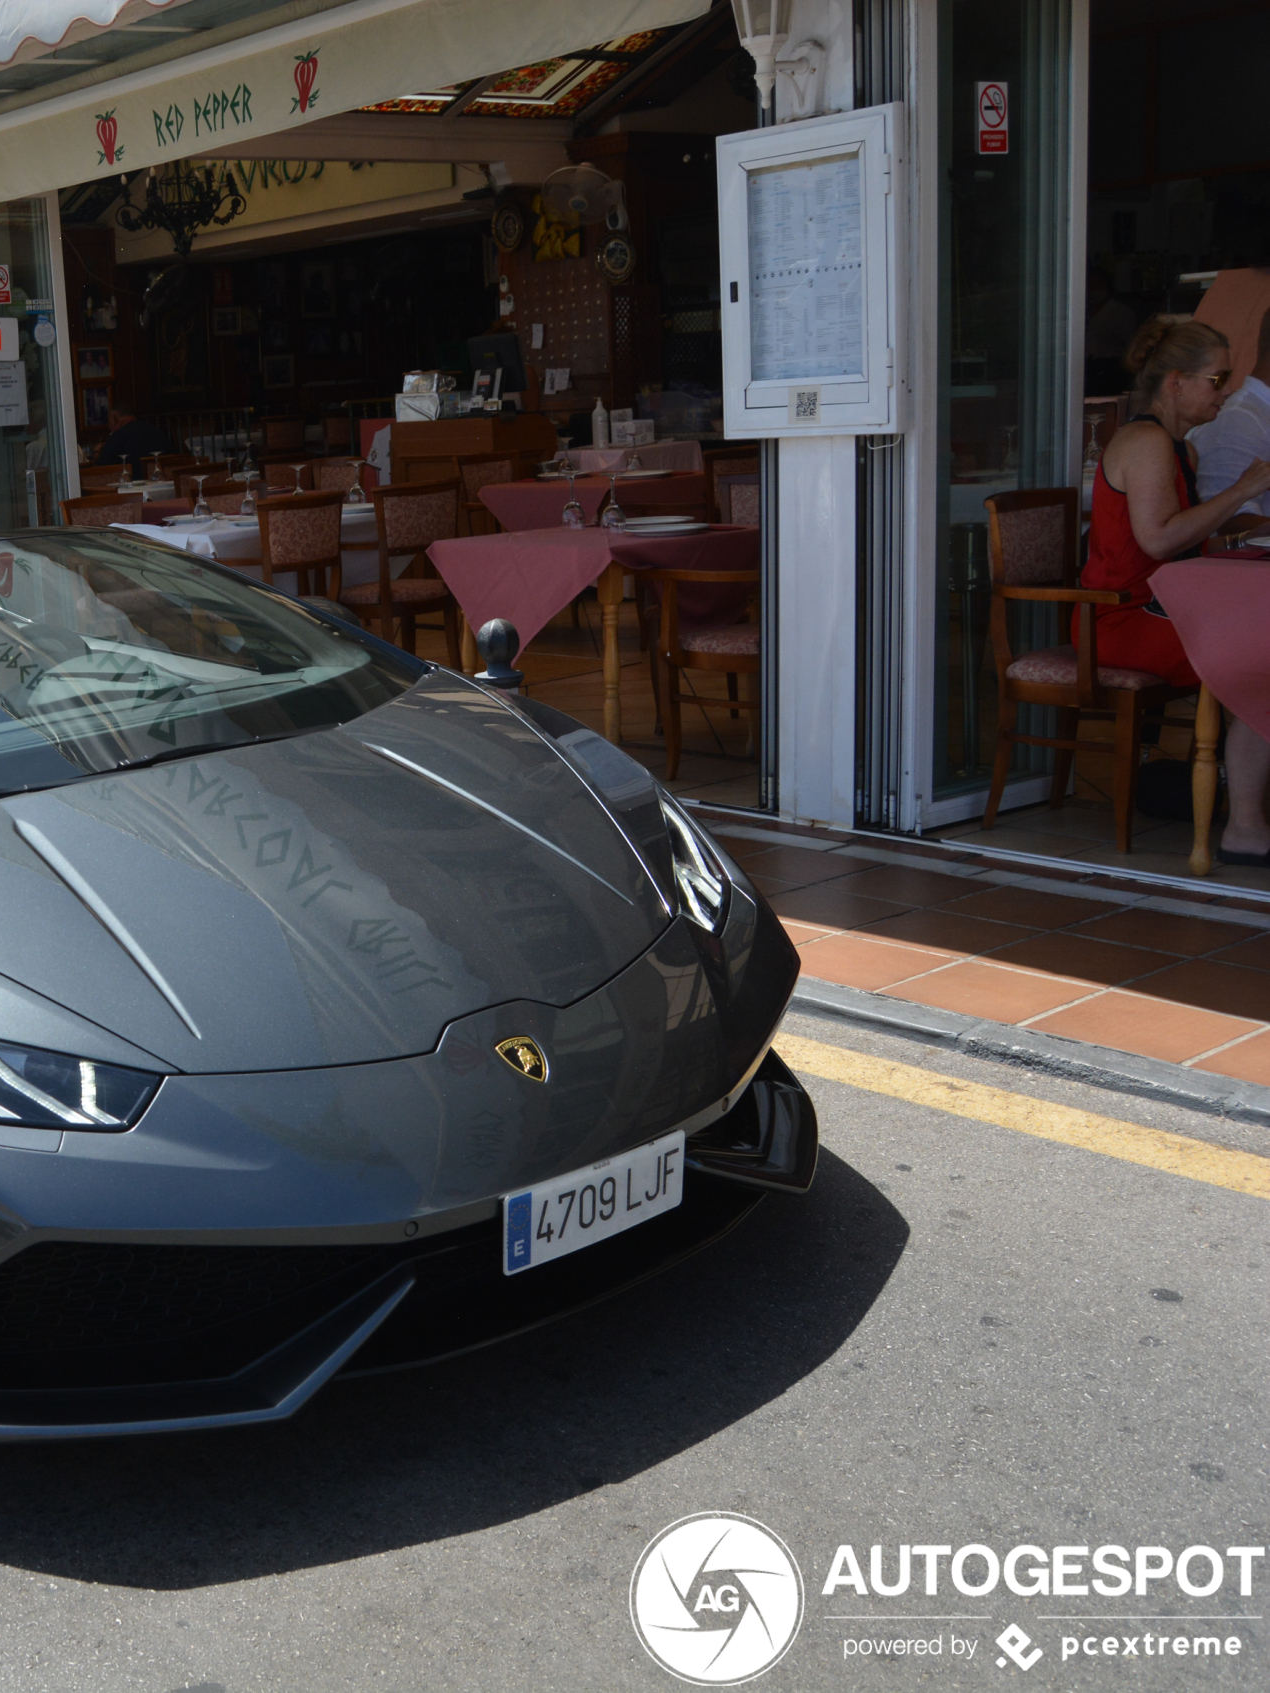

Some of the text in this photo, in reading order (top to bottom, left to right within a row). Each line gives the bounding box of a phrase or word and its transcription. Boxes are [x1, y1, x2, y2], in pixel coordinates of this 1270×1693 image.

[152, 82, 252, 147] RED PEPPER
[536, 1147, 680, 1244] 4709 LJF
[514, 1239, 525, 1257] E
